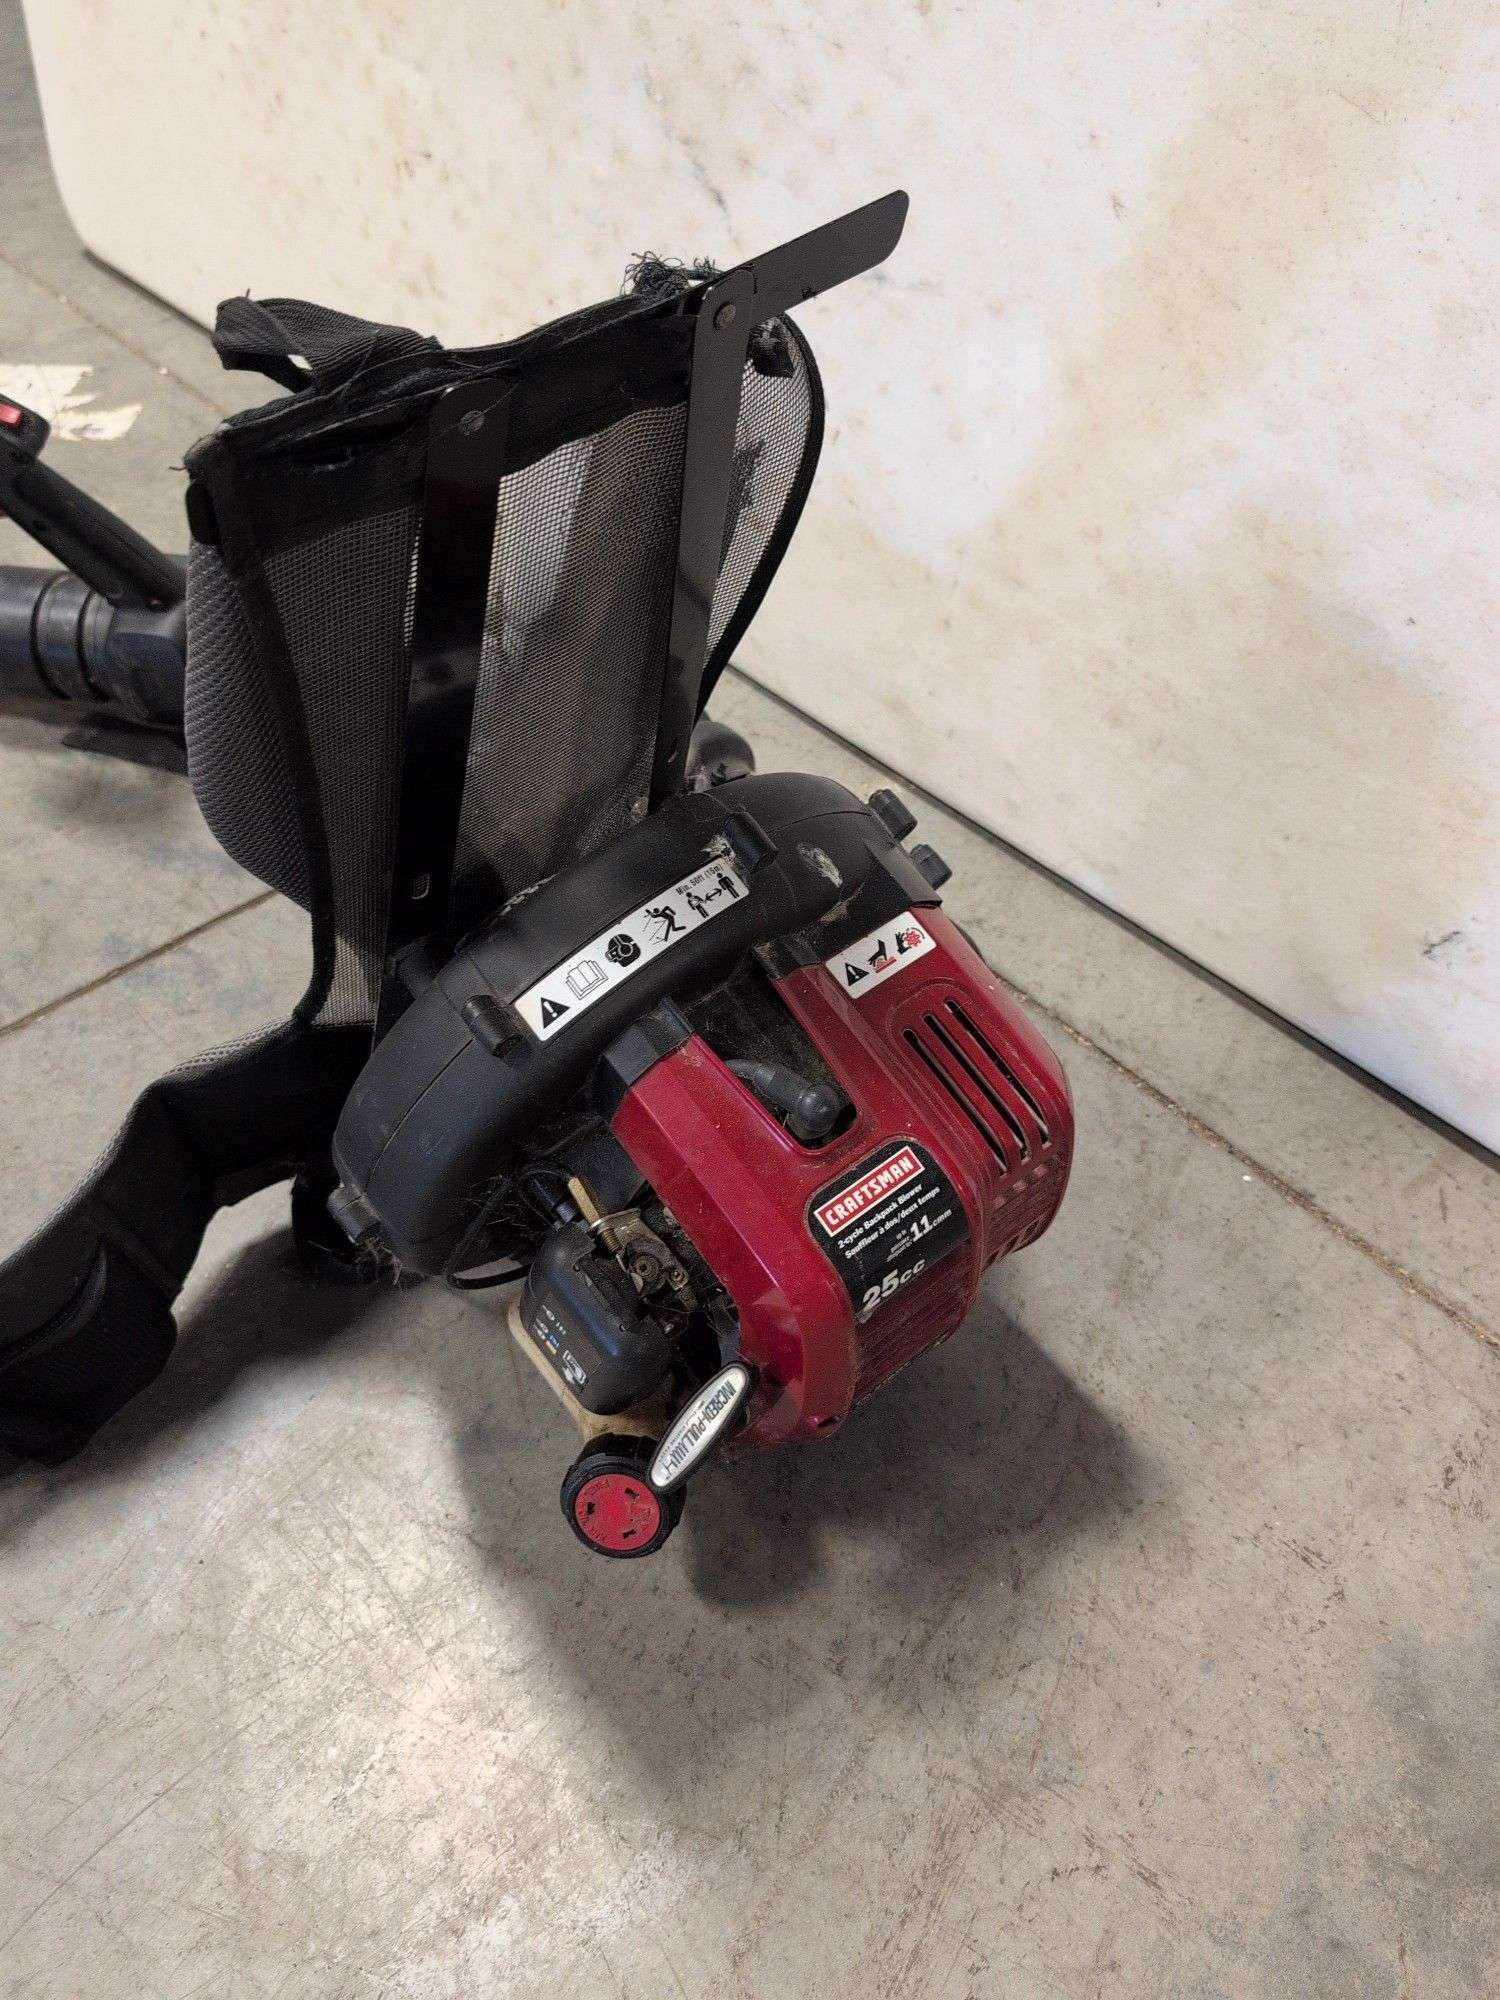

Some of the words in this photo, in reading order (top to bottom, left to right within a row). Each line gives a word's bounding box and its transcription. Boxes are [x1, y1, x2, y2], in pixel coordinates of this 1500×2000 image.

[675, 884, 693, 896] Min.
[690, 874, 706, 887] 50ft
[703, 864, 725, 879] (15m)
[825, 1156, 915, 1226] CRAFTSMAN
[837, 1225, 864, 1249] 2-cycle
[863, 1201, 899, 1231] Backpack
[897, 1184, 923, 1205] Blower
[917, 1186, 941, 1208] temps
[856, 1258, 926, 1324] 25cc
